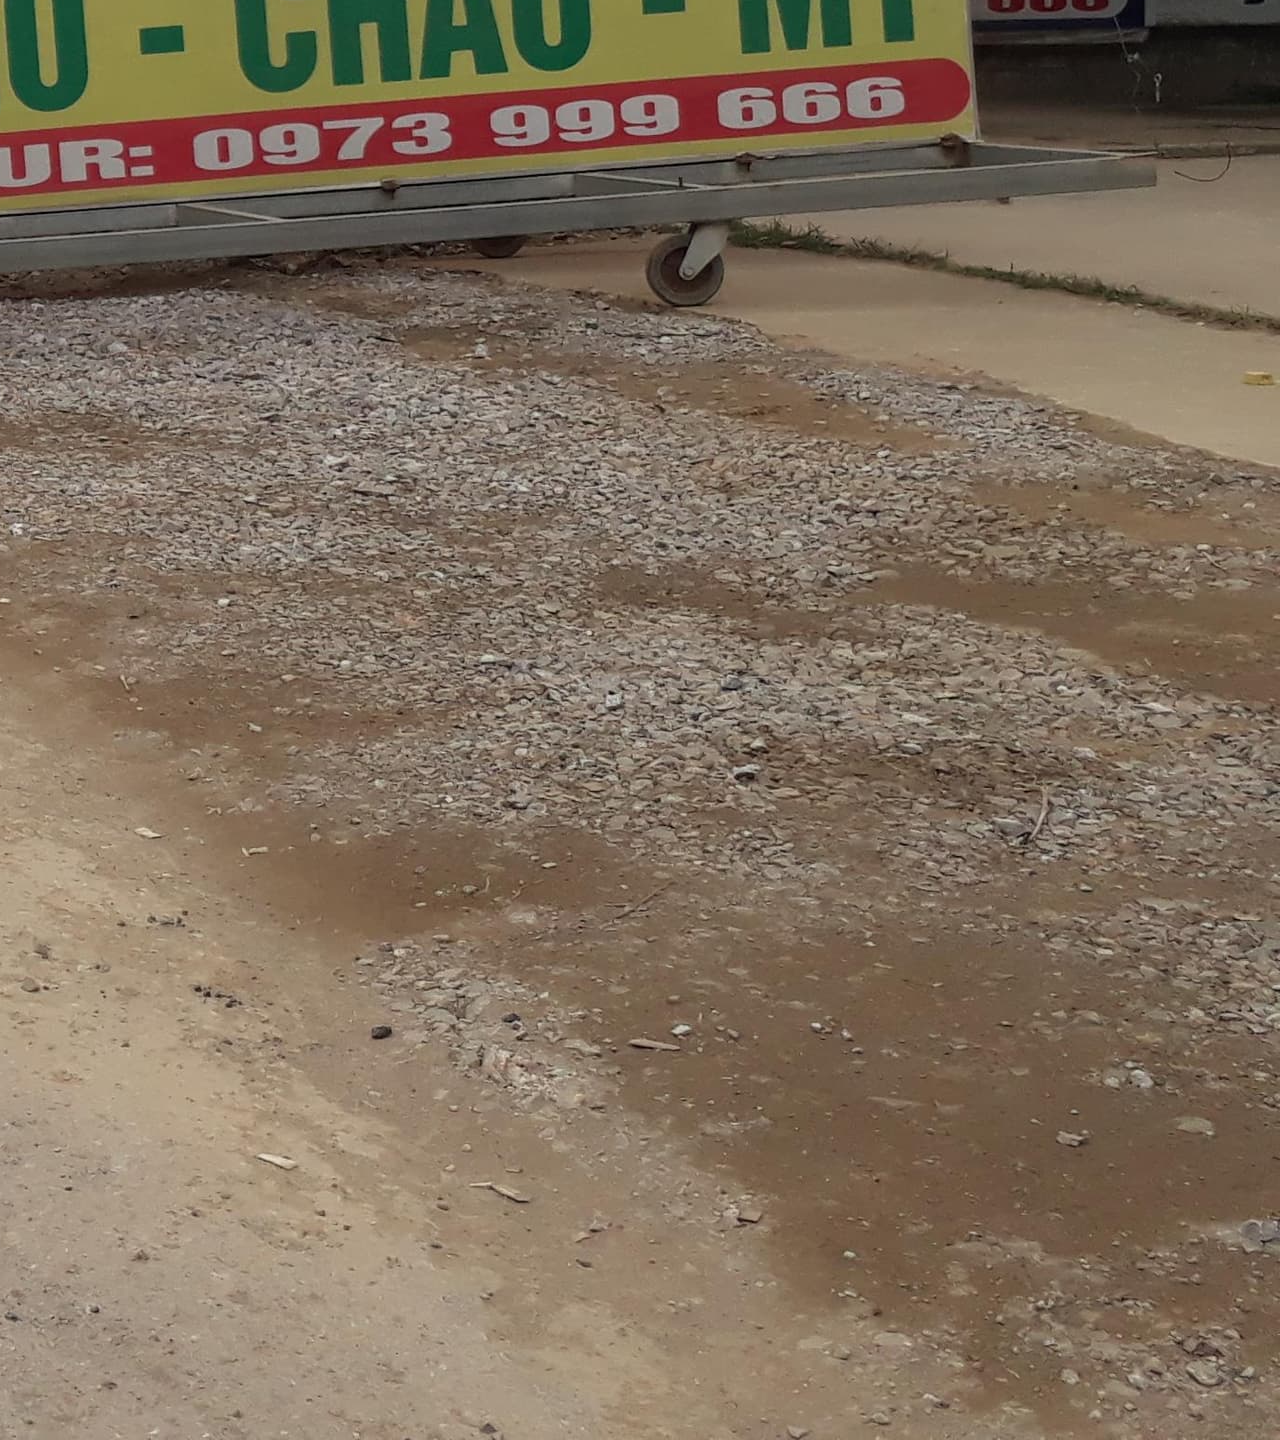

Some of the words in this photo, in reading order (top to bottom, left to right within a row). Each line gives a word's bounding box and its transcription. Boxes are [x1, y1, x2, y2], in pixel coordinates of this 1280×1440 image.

[192, 111, 453, 172] 0973
[489, 93, 681, 148] 999
[717, 76, 906, 130] 666
